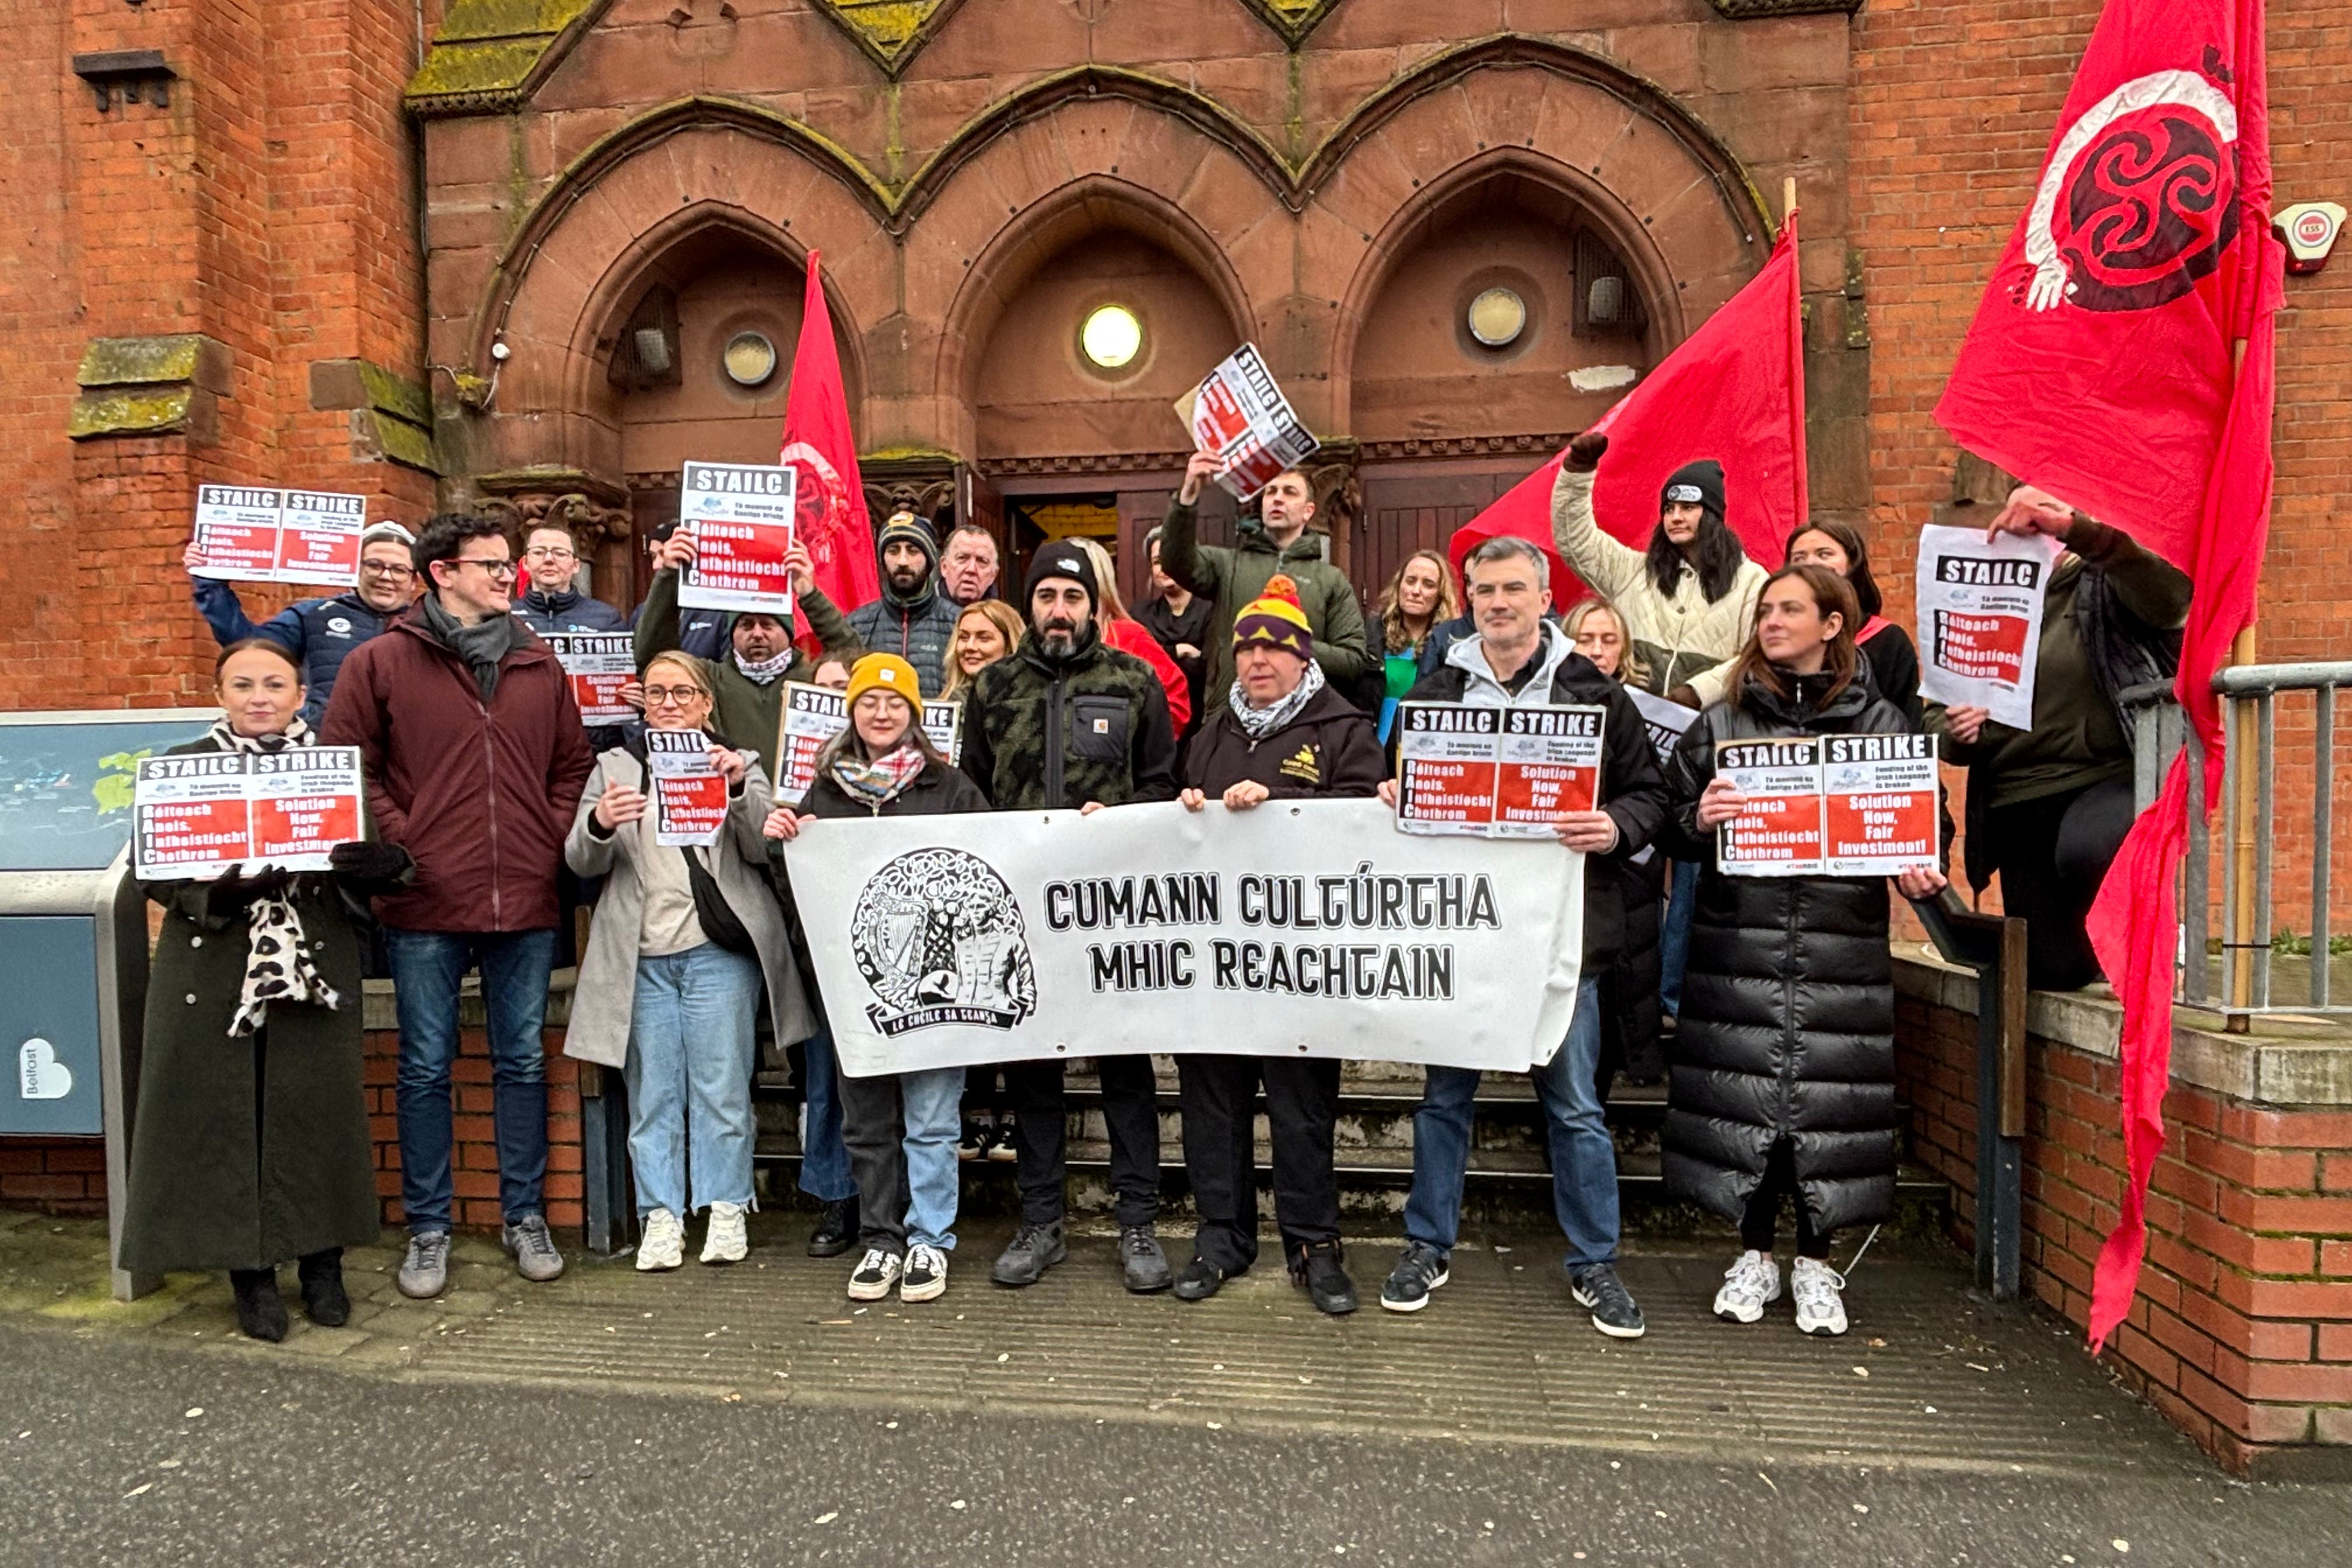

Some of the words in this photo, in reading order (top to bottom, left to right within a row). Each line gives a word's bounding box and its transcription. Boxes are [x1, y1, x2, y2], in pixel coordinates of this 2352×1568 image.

[697, 470, 782, 494] STAILC
[208, 489, 274, 508] STAILC
[292, 495, 358, 513] STRIKE
[688, 569, 759, 590] Chothrom
[1945, 560, 2032, 586] STAILC
[573, 639, 632, 653] STRIKE
[1413, 709, 1492, 732] STAILC
[1511, 712, 1595, 736] STRIKE
[1726, 744, 1810, 767] STAILC
[1832, 735, 1926, 762] STRIKE
[149, 757, 239, 779] STAILC
[259, 752, 349, 772] STRIKE
[1406, 760, 1464, 777] Réiteach
[1520, 765, 1576, 781] Solution
[275, 798, 335, 812] Solution
[1531, 793, 1558, 808] Fair
[1849, 795, 1912, 810] Solution
[143, 804, 211, 818] Réiteach
[1404, 804, 1466, 820] Chothrom
[292, 825, 320, 838] Fair
[1866, 825, 1894, 839] Fair
[144, 849, 219, 863] Chothrom
[1726, 845, 1793, 859] Chothrom
[1838, 839, 1926, 855] Investment!
[1045, 872, 1222, 932] CUMANN
[1238, 861, 1503, 930] CULTÚRTHA
[1088, 938, 1195, 993] MHIC
[1209, 937, 1455, 1001] REACHTAIN
[26, 1048, 38, 1094] Belfast
